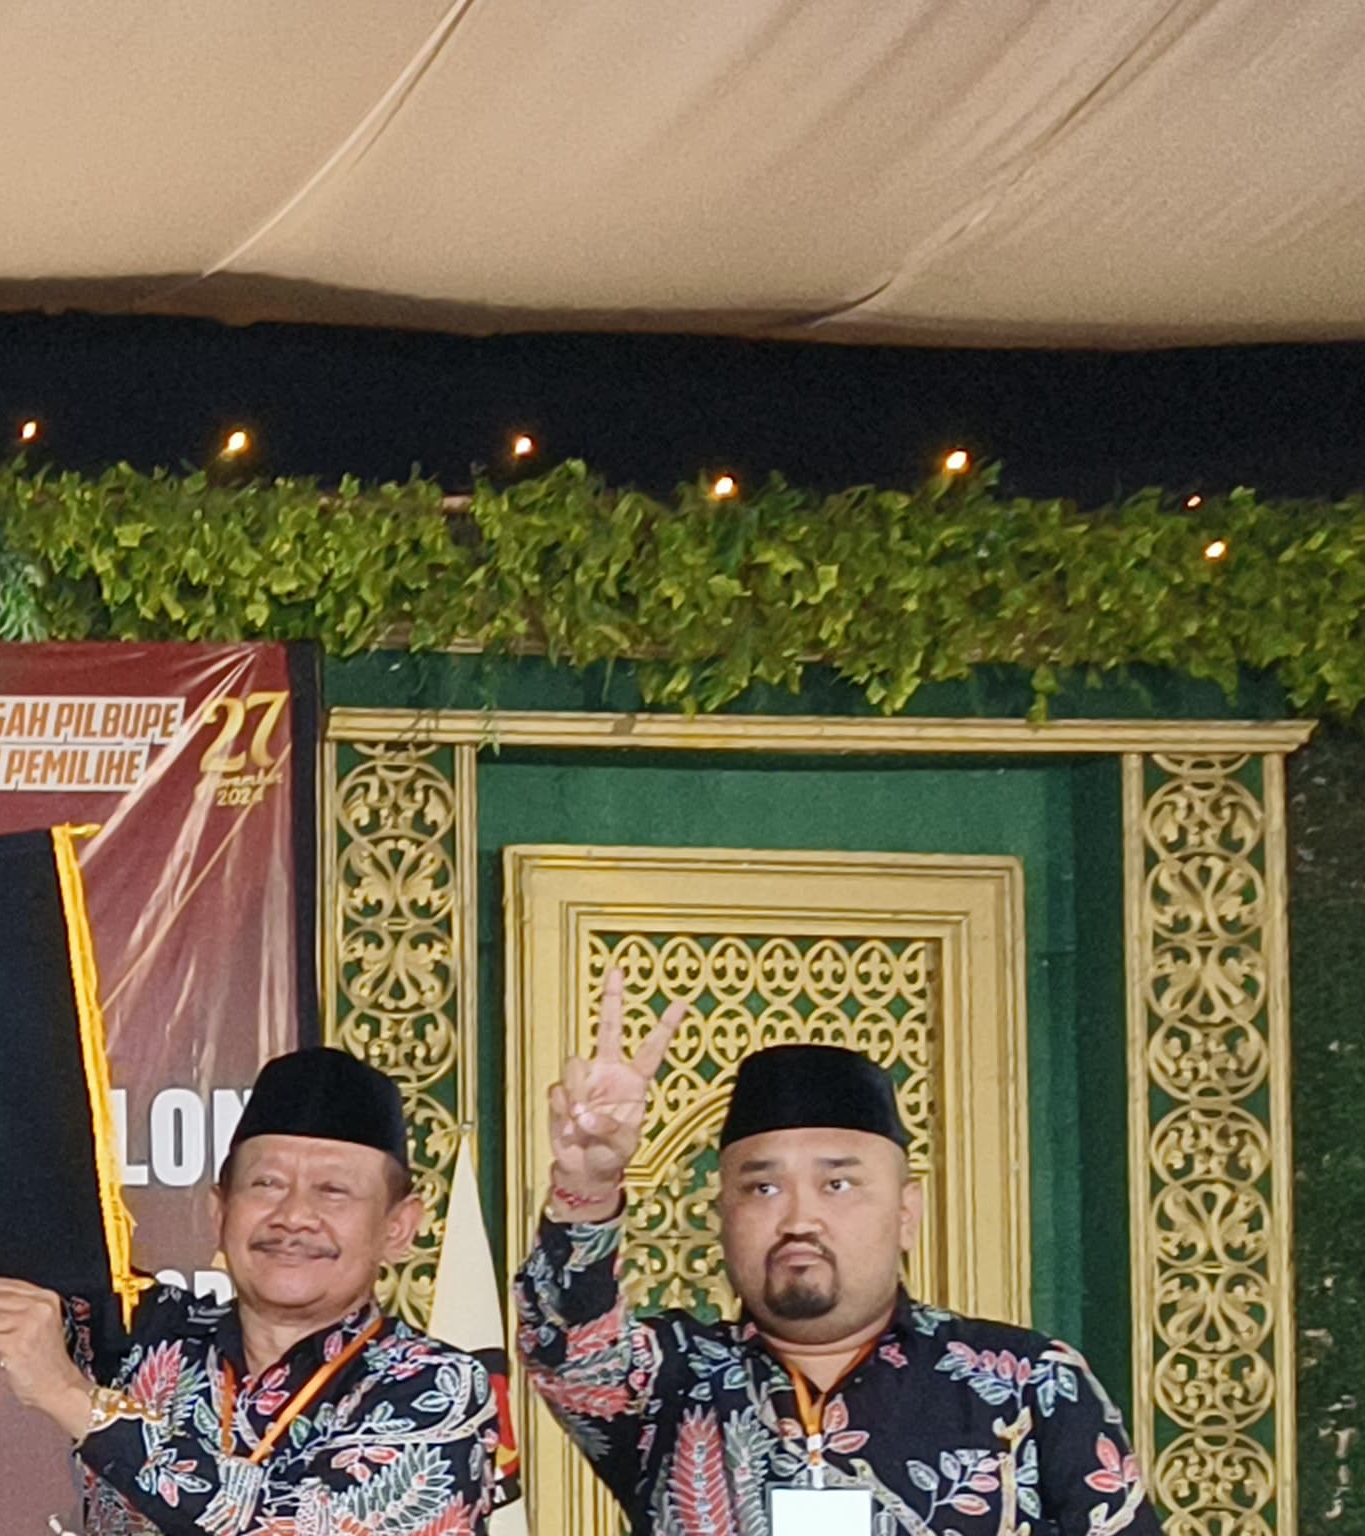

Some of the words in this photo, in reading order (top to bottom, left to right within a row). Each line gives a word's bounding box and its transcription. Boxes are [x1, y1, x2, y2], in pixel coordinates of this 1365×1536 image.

[55, 702, 179, 742] PILBUPE
[200, 690, 289, 772] 27
[5, 750, 143, 789] PEMILIHE
